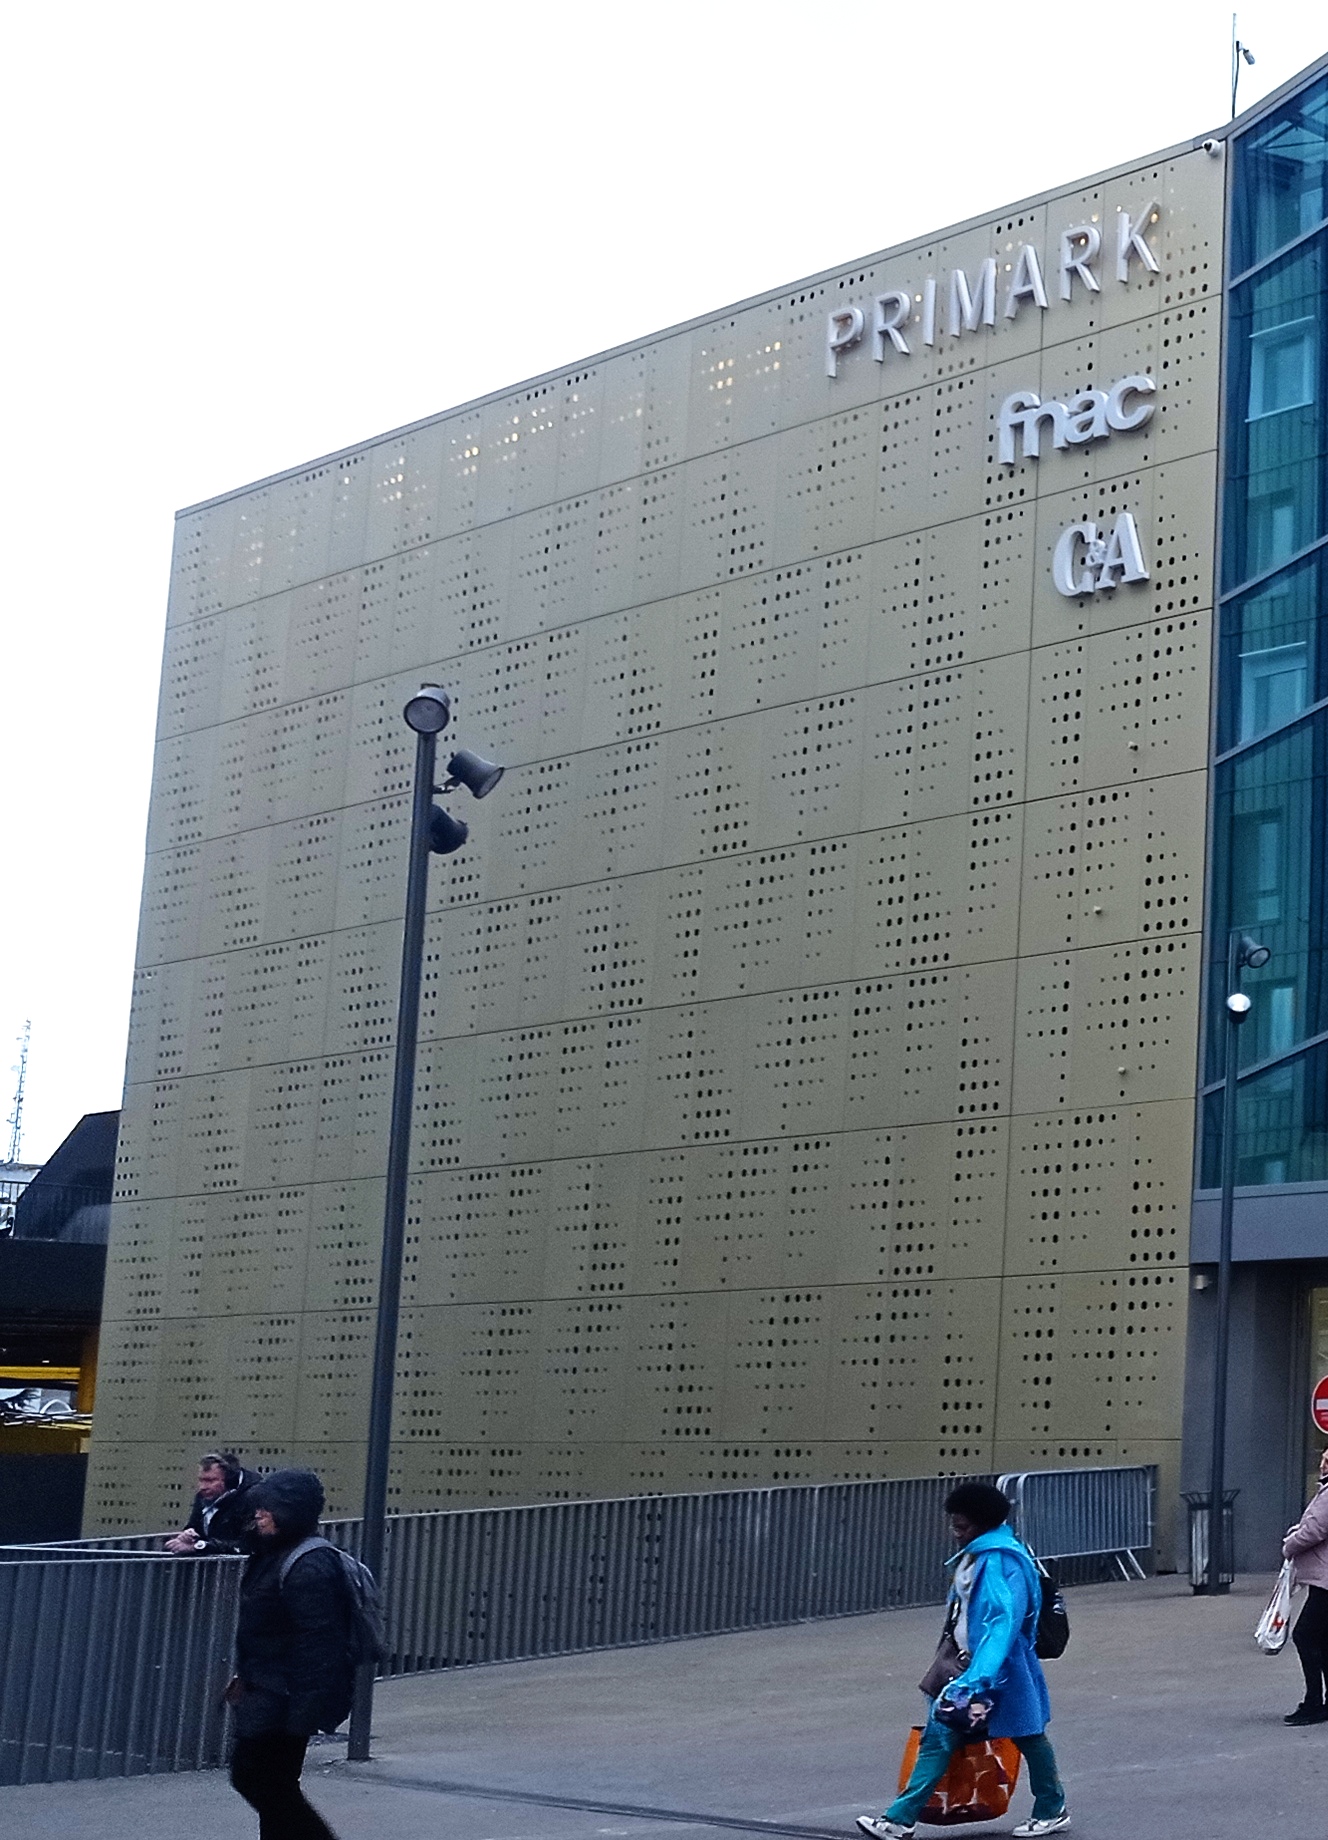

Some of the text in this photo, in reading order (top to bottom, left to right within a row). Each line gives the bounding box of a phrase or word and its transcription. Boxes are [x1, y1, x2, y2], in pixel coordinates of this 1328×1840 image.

[825, 201, 1162, 379] PRIMARK
[998, 375, 1157, 466] fnac
[1052, 511, 1150, 597] C&A
